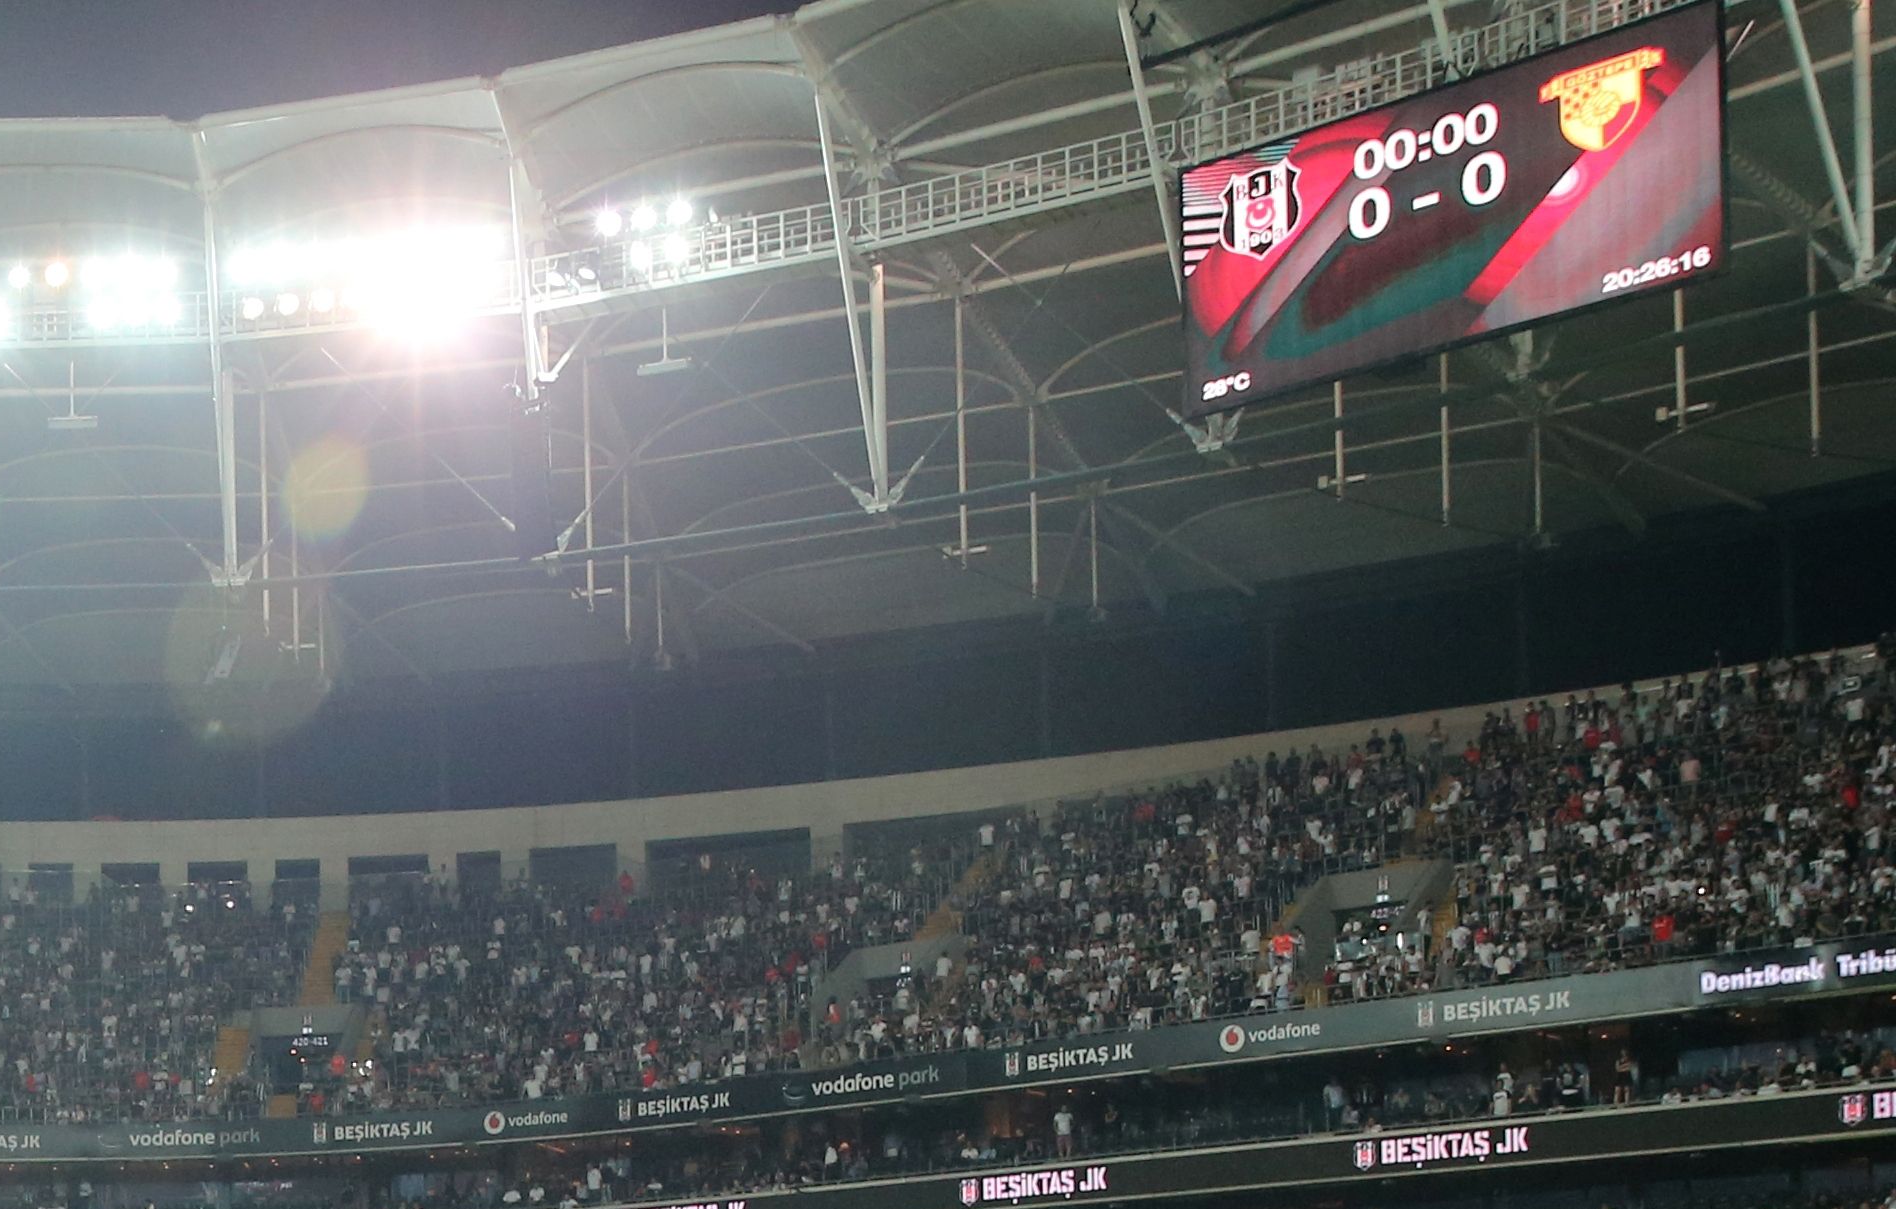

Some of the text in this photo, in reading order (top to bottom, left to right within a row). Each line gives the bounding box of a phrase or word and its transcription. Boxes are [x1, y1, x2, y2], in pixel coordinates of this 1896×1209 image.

[1353, 102, 1498, 180] 00:00
[1348, 186, 1391, 239] 0
[1461, 151, 1507, 206] 0
[1602, 245, 1711, 293] 20:26:16
[1700, 957, 1827, 994] DenizBank
[1443, 990, 1570, 1024] BEŞİKTAŞ JK
[1248, 1022, 1320, 1043] vodafone
[1026, 1043, 1133, 1073] BEŞİKTAŞ JK
[812, 1065, 940, 1095] vodafone park
[508, 1110, 568, 1128] vodafone
[637, 1092, 730, 1118] BEŞİKTAŞ JK
[21, 1135, 40, 1149] JK
[129, 1128, 261, 1147] vodafone park
[334, 1120, 433, 1144] BEŞİKTAŞ JK
[1381, 1126, 1529, 1168] BEŞİKTAŞ JK
[982, 1166, 1107, 1204] BEŞİKTAŞ JK
